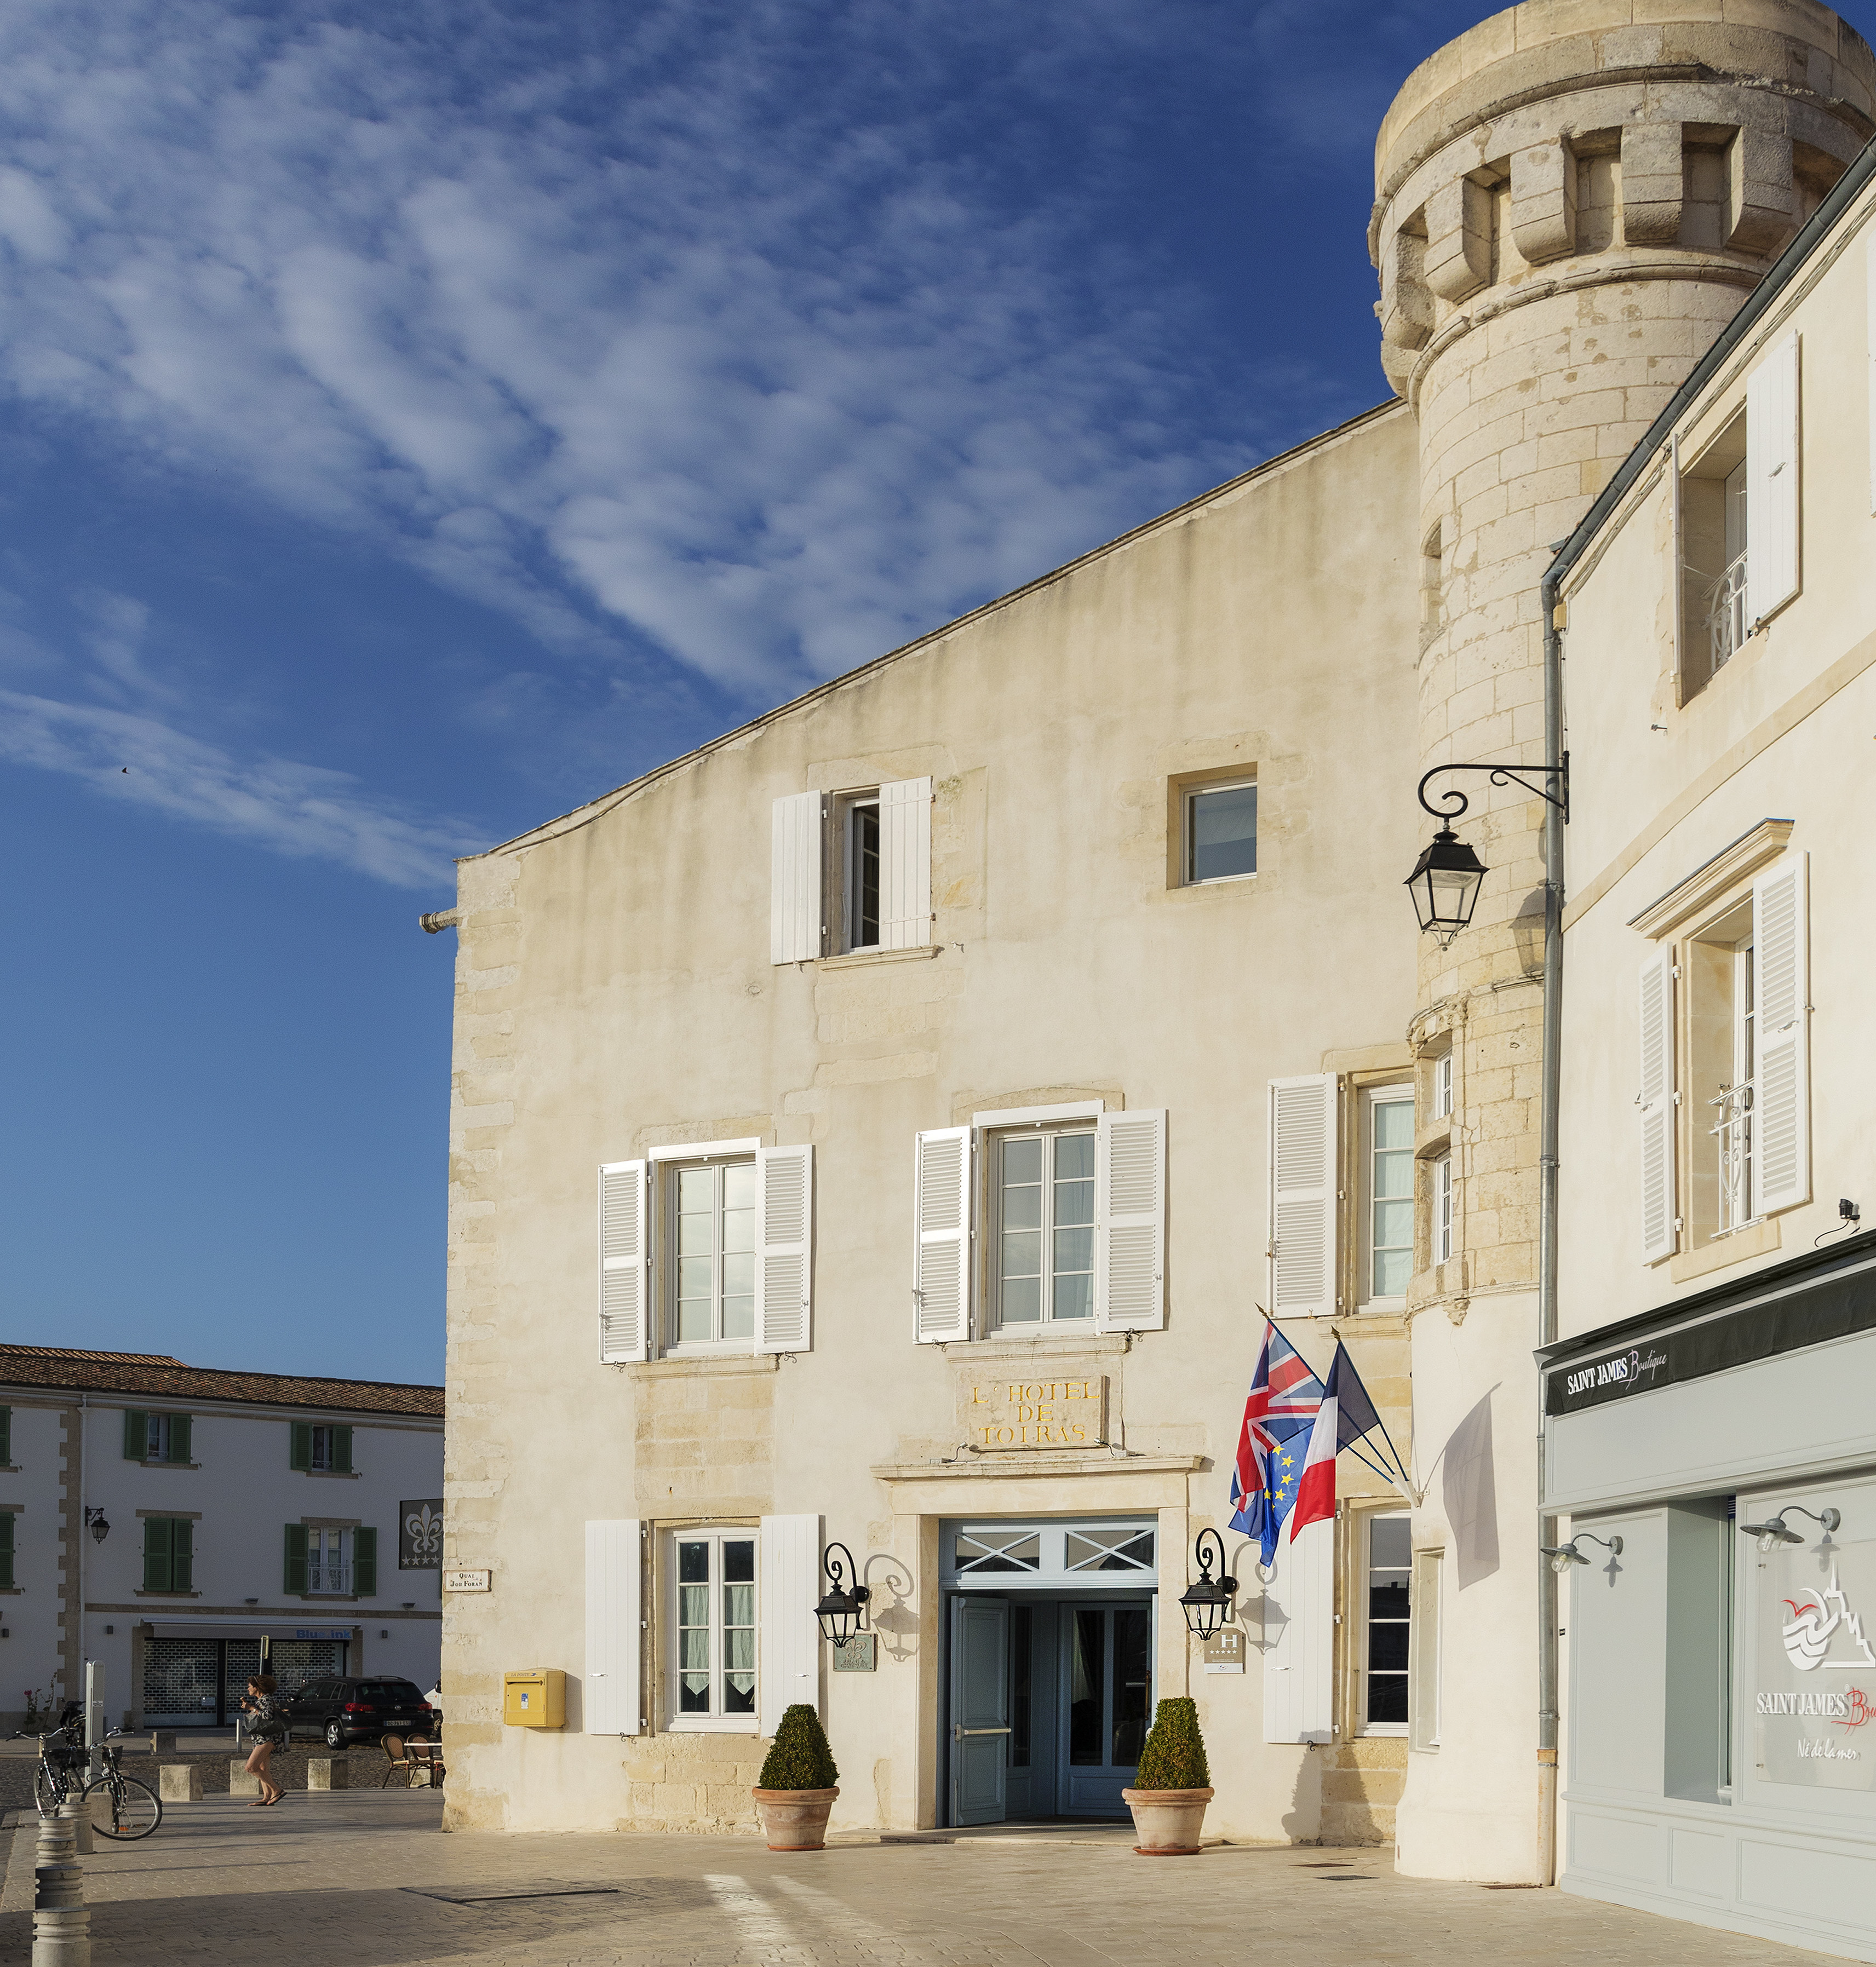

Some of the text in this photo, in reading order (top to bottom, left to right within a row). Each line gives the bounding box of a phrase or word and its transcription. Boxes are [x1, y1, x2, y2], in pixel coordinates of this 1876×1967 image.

[1567, 1349, 1668, 1395] SAINT JAMES Boutique
[1016, 1404, 1054, 1423] DE
[979, 1424, 1086, 1445] TOIRAS
[1220, 1634, 1239, 1648] H
[1757, 1693, 1797, 1715] SAINT
[1798, 1693, 1845, 1716] JAMES
[1797, 1738, 1810, 1758] Né
[1824, 1738, 1835, 1758] la
[1836, 1748, 1856, 1760] mer
